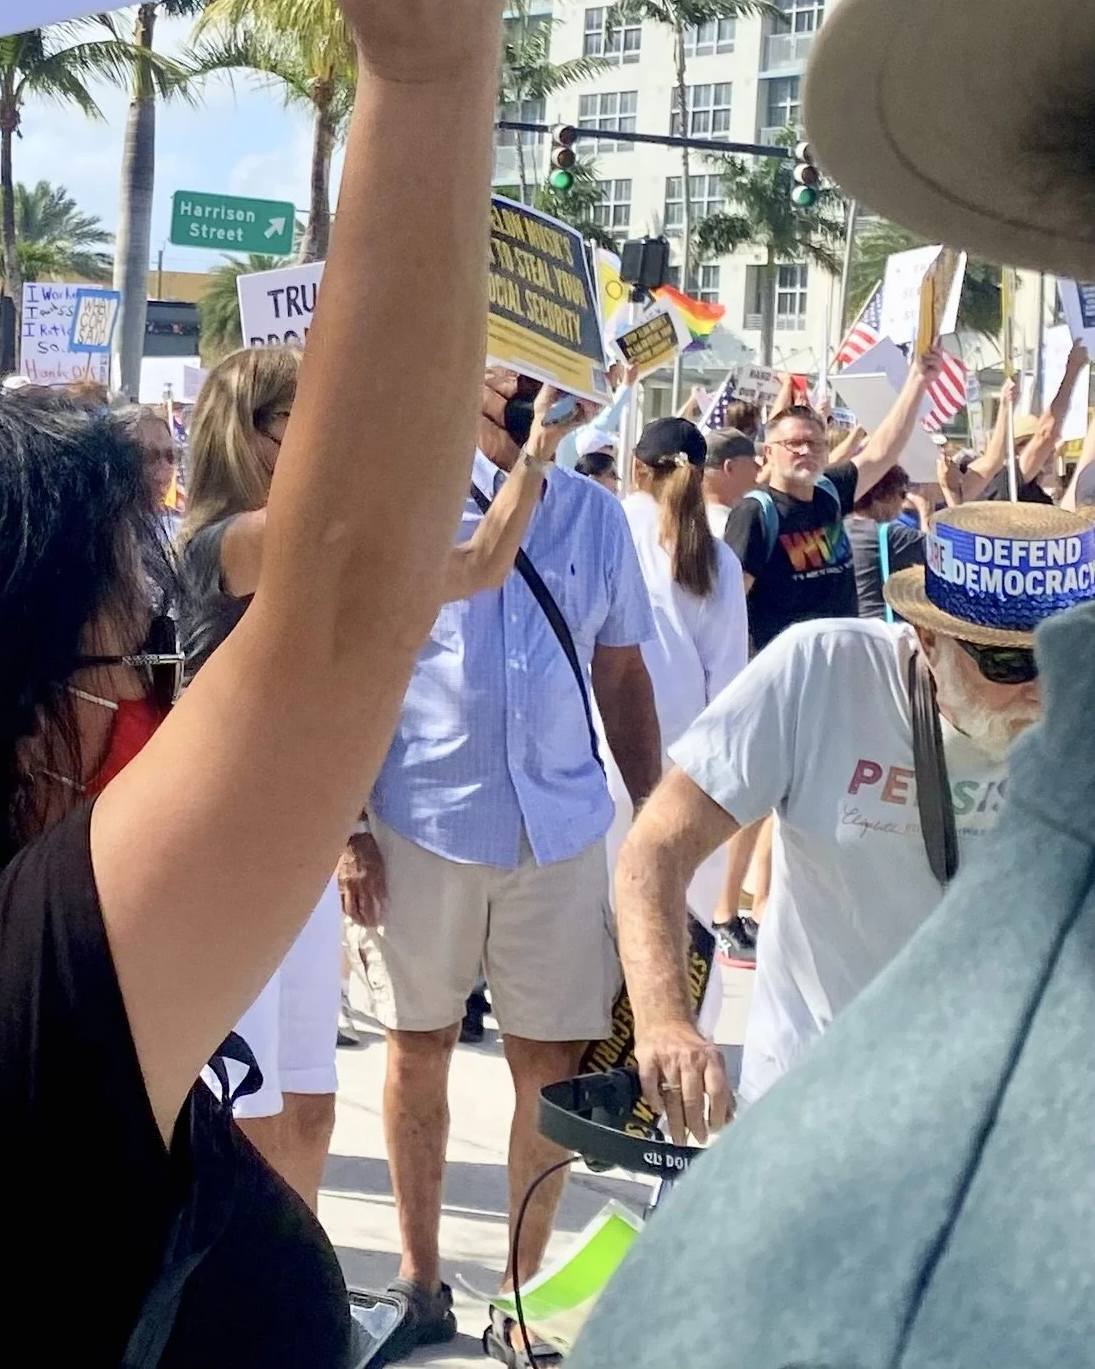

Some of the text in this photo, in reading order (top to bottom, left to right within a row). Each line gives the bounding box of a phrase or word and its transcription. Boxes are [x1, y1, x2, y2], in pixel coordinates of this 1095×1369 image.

[180, 201, 255, 223] Harrison
[189, 222, 244, 242] Street
[974, 536, 1082, 567] DEFEND
